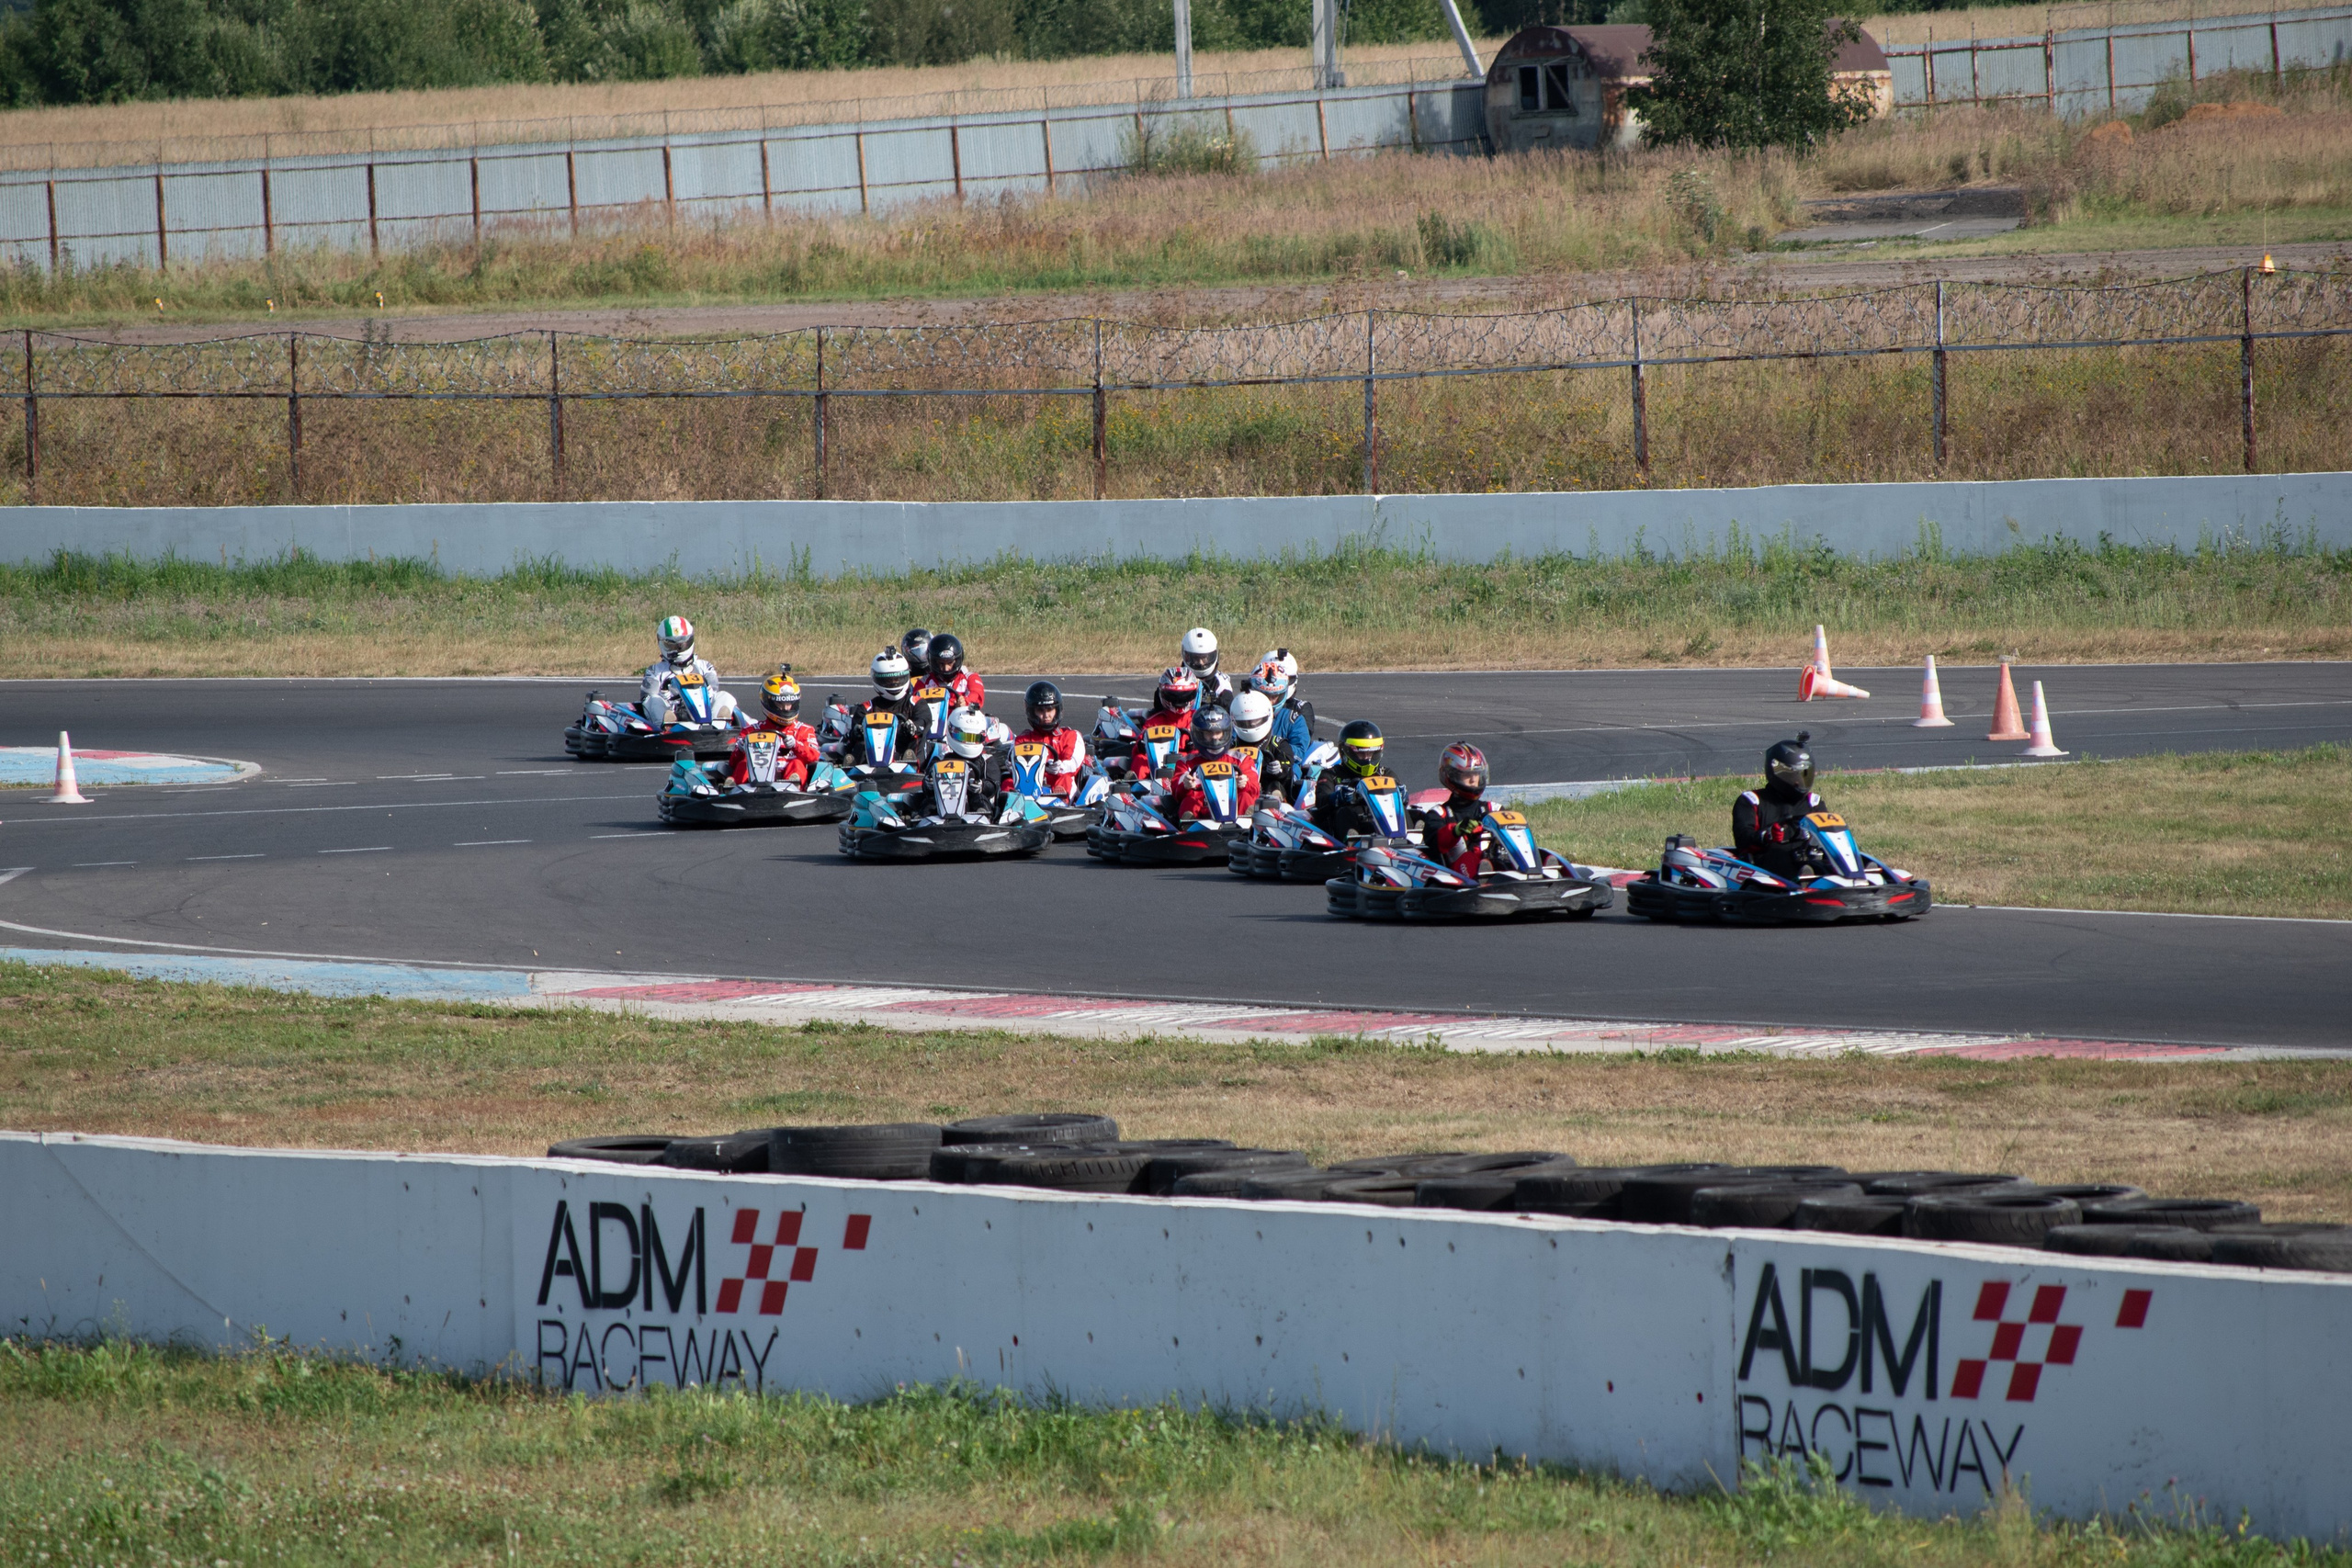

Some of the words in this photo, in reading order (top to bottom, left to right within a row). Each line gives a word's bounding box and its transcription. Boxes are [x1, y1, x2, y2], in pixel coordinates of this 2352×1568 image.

[682, 673, 700, 682] 13
[1153, 727, 1171, 736] 16
[1023, 744, 1034, 752] 9
[753, 754, 768, 766] 5
[944, 761, 956, 770] 4
[1205, 764, 1229, 774] 20
[1369, 778, 1388, 786] 17
[943, 784, 959, 797] 4
[1501, 812, 1515, 820] 6
[1815, 814, 1839, 823] 14
[537, 1200, 707, 1314] ADM
[1737, 1262, 1942, 1401] ADM
[537, 1318, 779, 1396] RACEWAY
[1737, 1393, 2025, 1498] RACEWAY
